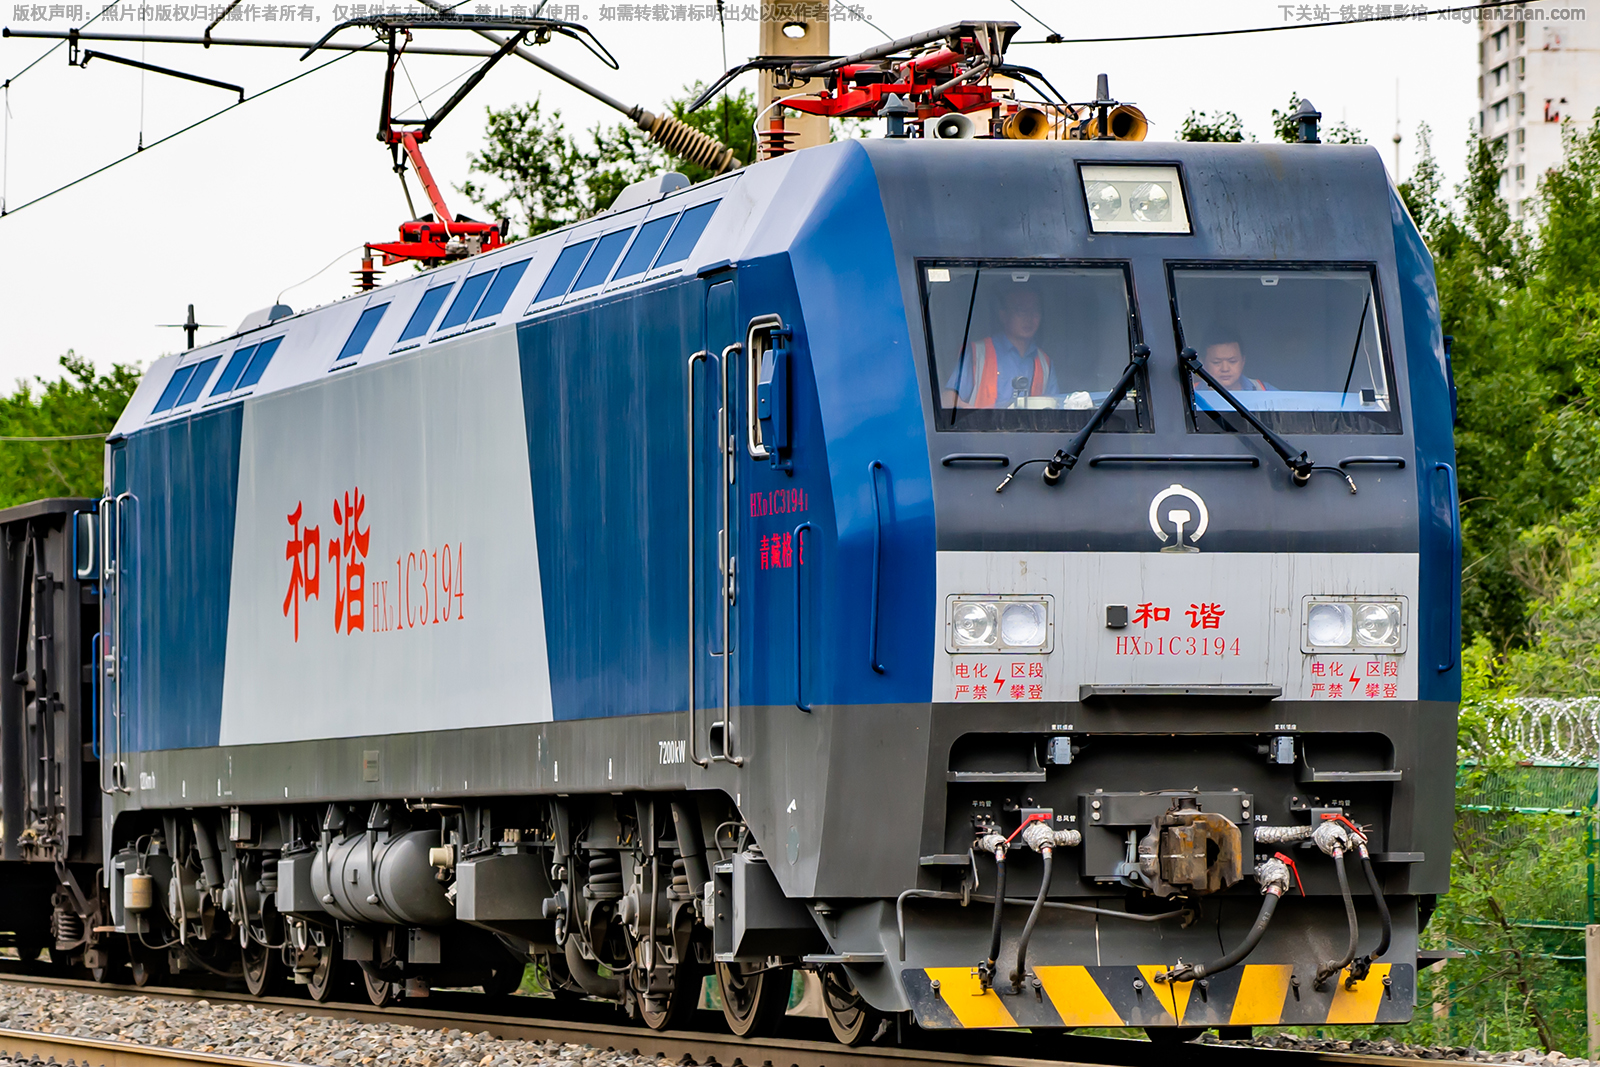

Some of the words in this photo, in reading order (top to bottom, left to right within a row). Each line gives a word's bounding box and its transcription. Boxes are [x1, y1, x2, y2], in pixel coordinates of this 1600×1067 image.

[283, 486, 371, 643] 和谐
[1132, 602, 1225, 629] 和谐
[1116, 636, 1241, 656] HXD1C3194
[955, 662, 988, 678] 电化
[1011, 662, 1043, 678] 区段
[1311, 661, 1344, 677] 电化
[1366, 661, 1398, 677] 区段
[954, 684, 988, 700] 严禁
[1010, 684, 1043, 700] 攀登
[1310, 683, 1343, 698] 严禁
[1365, 683, 1397, 699] 攀登
[658, 740, 686, 765] 7200kW
